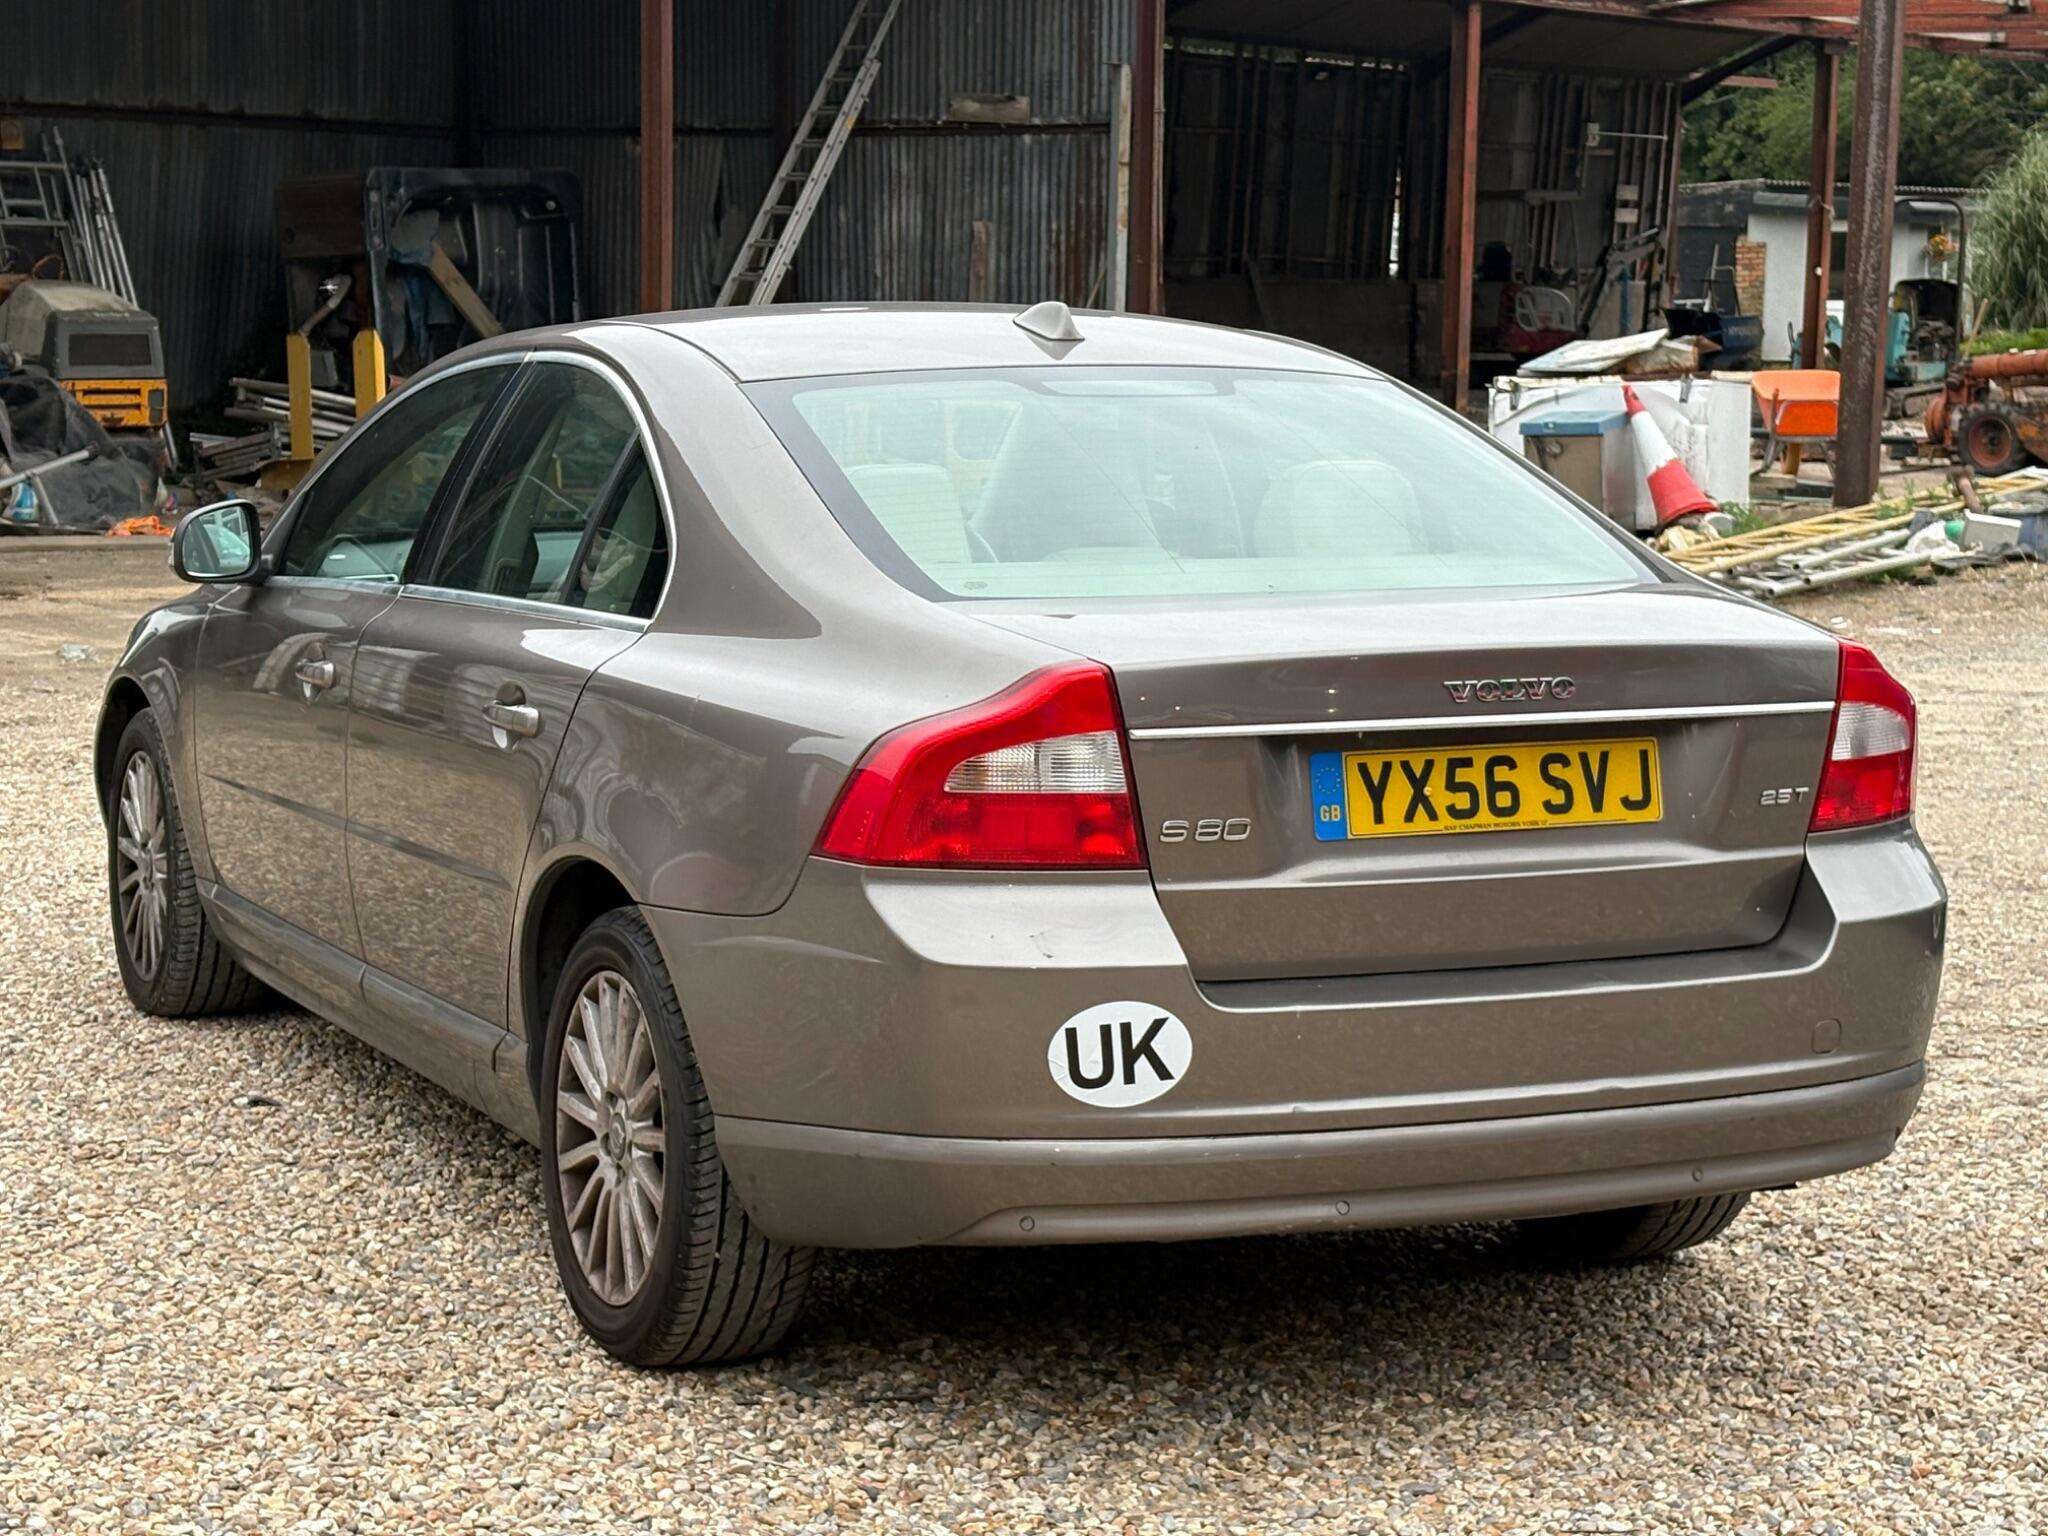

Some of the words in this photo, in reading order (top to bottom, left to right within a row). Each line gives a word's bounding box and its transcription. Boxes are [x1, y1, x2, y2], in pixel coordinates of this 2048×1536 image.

[1444, 677, 1576, 703] VOLVO
[1356, 753, 1521, 825] YX56
[1538, 748, 1653, 816] SVJ
[1320, 805, 1340, 821] GB
[1065, 1016, 1175, 1090] UK
